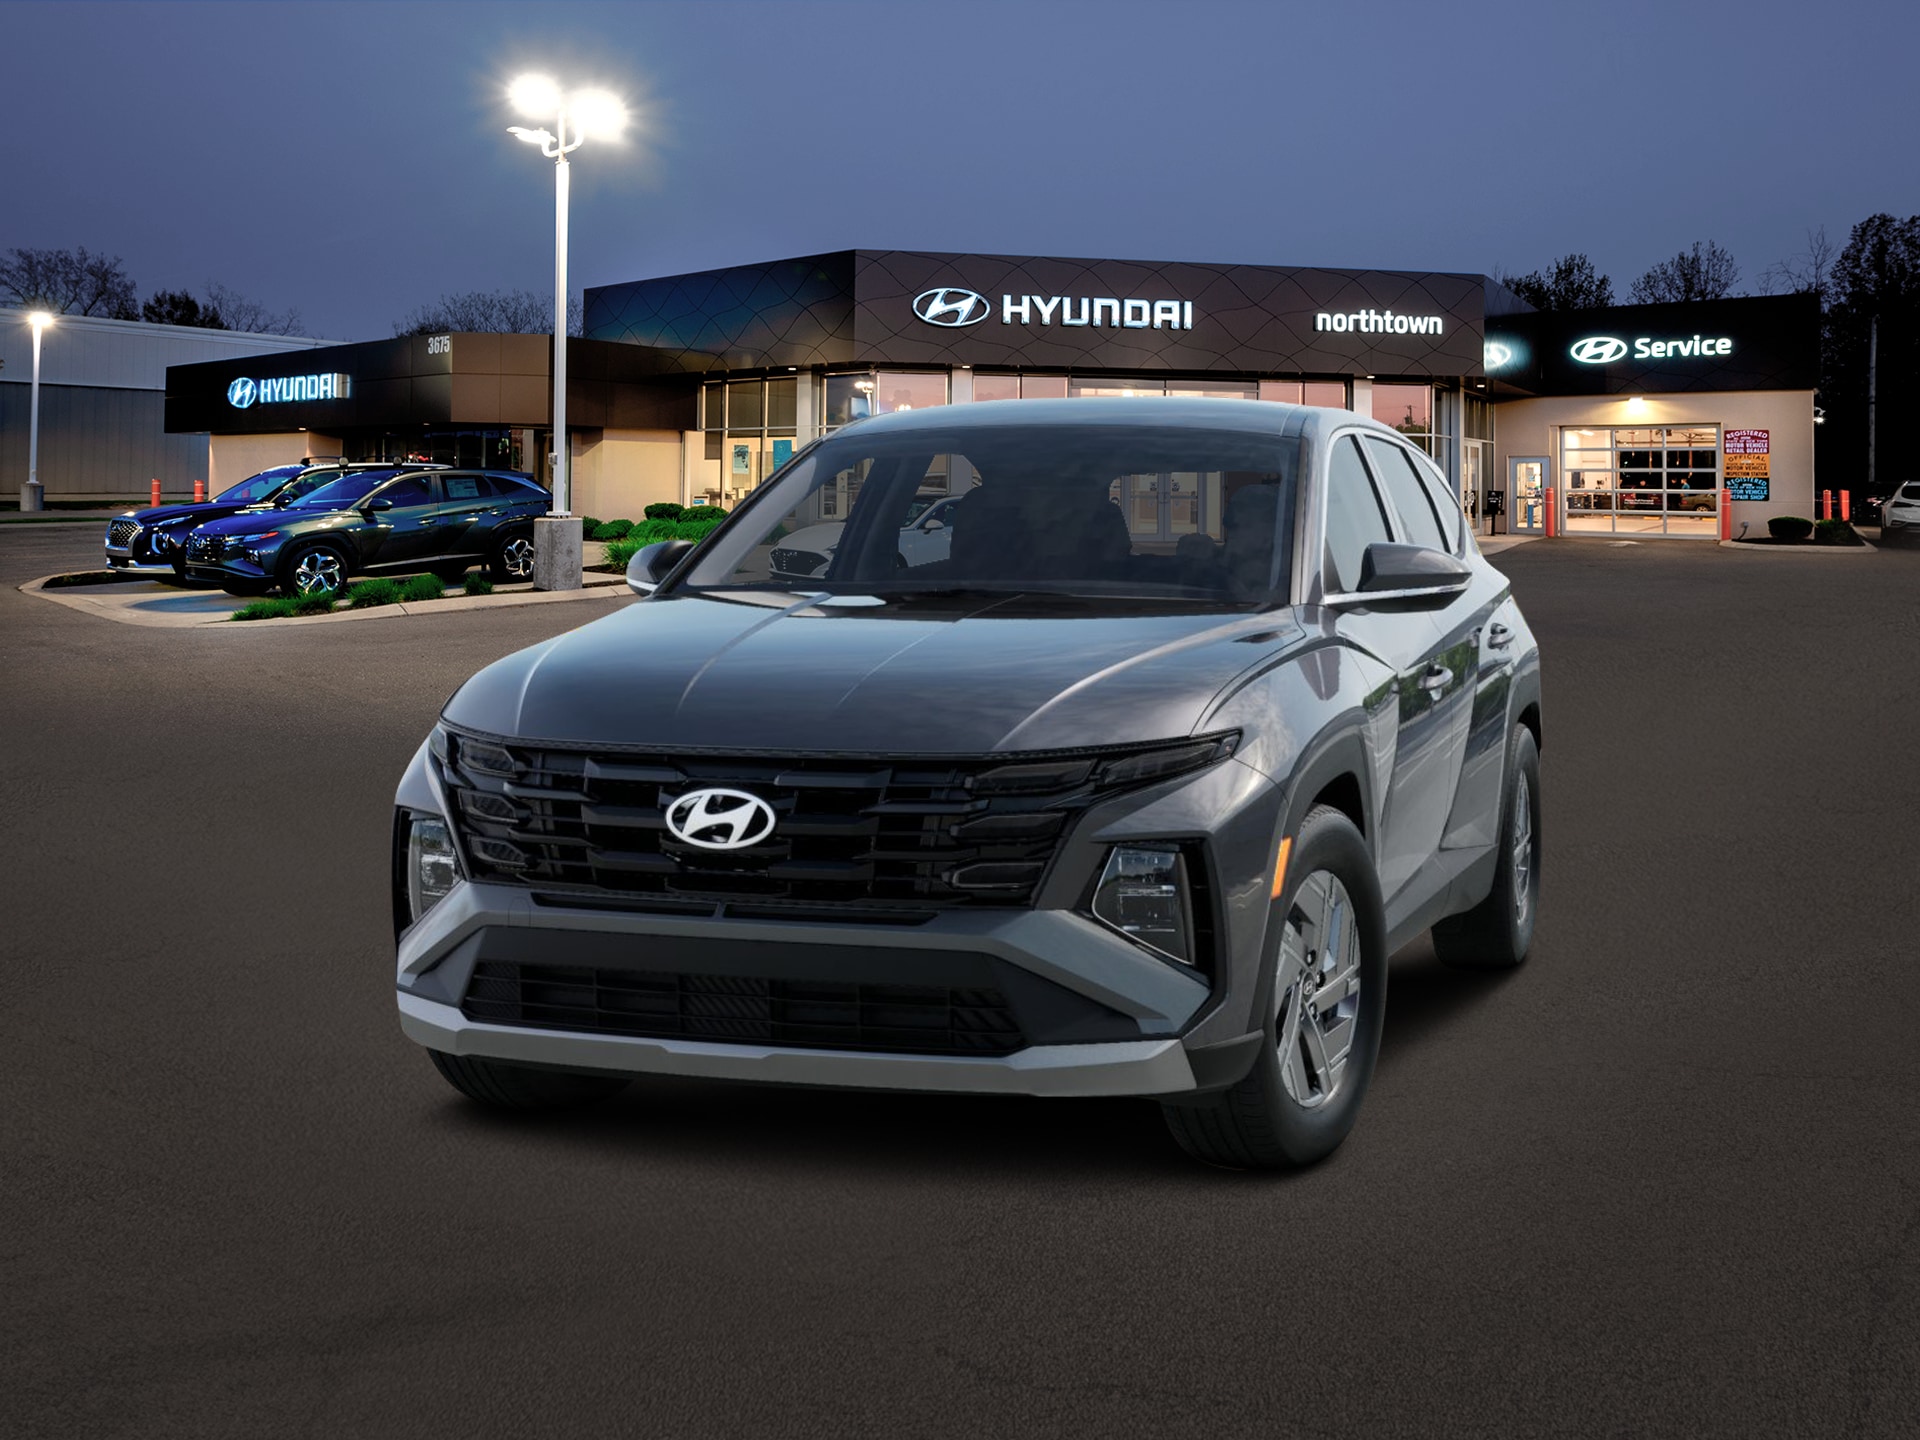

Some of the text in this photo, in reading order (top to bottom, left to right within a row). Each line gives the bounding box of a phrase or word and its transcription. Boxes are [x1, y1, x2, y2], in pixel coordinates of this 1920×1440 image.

[1003, 295, 1192, 330] HYUNDAI
[1315, 310, 1443, 335] northtown
[428, 335, 450, 354] 3675
[1634, 335, 1732, 358] Service
[260, 373, 340, 403] HYUNDAI
[1726, 430, 1768, 439] REGISTERED
[1728, 454, 1765, 462] OFFICIAL
[1726, 477, 1767, 487] REGISTERED
